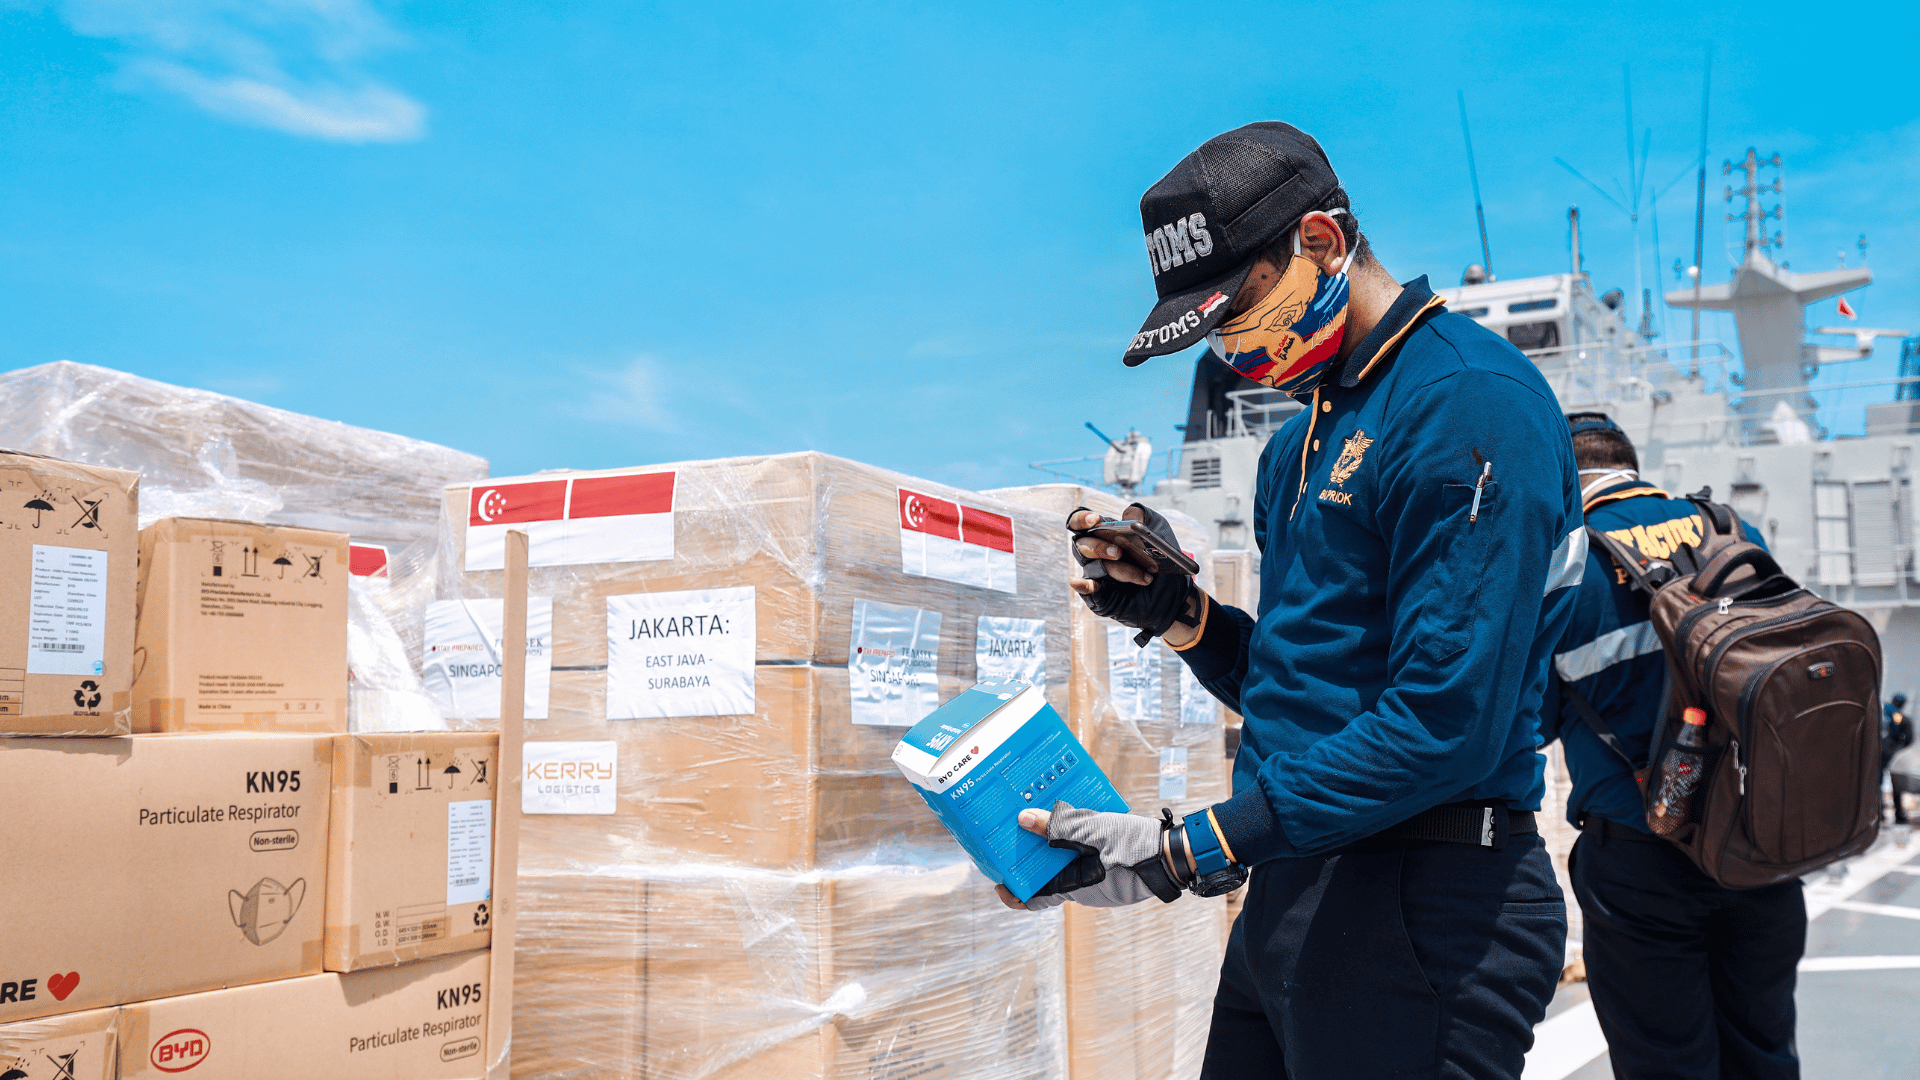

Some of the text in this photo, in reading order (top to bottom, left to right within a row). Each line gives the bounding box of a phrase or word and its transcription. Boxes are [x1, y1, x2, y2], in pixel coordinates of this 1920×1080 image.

[629, 614, 730, 640] JAKARTA:
[646, 655, 673, 668] EAST
[676, 653, 706, 667] JAVA
[648, 675, 711, 690] SURABAYA
[527, 762, 613, 780] KERRY
[938, 754, 973, 784] BYD CARE
[246, 770, 301, 794] KN95
[538, 784, 601, 794] LOGISTICS
[949, 778, 975, 801] KN95
[139, 803, 301, 826] Particulate Respirator
[253, 834, 296, 846] Non-sterile
[437, 983, 482, 1010] KN95
[350, 1014, 482, 1053] Particulate Respirator
[158, 1039, 203, 1063] BYD
[443, 1041, 478, 1057] Non-sterile
